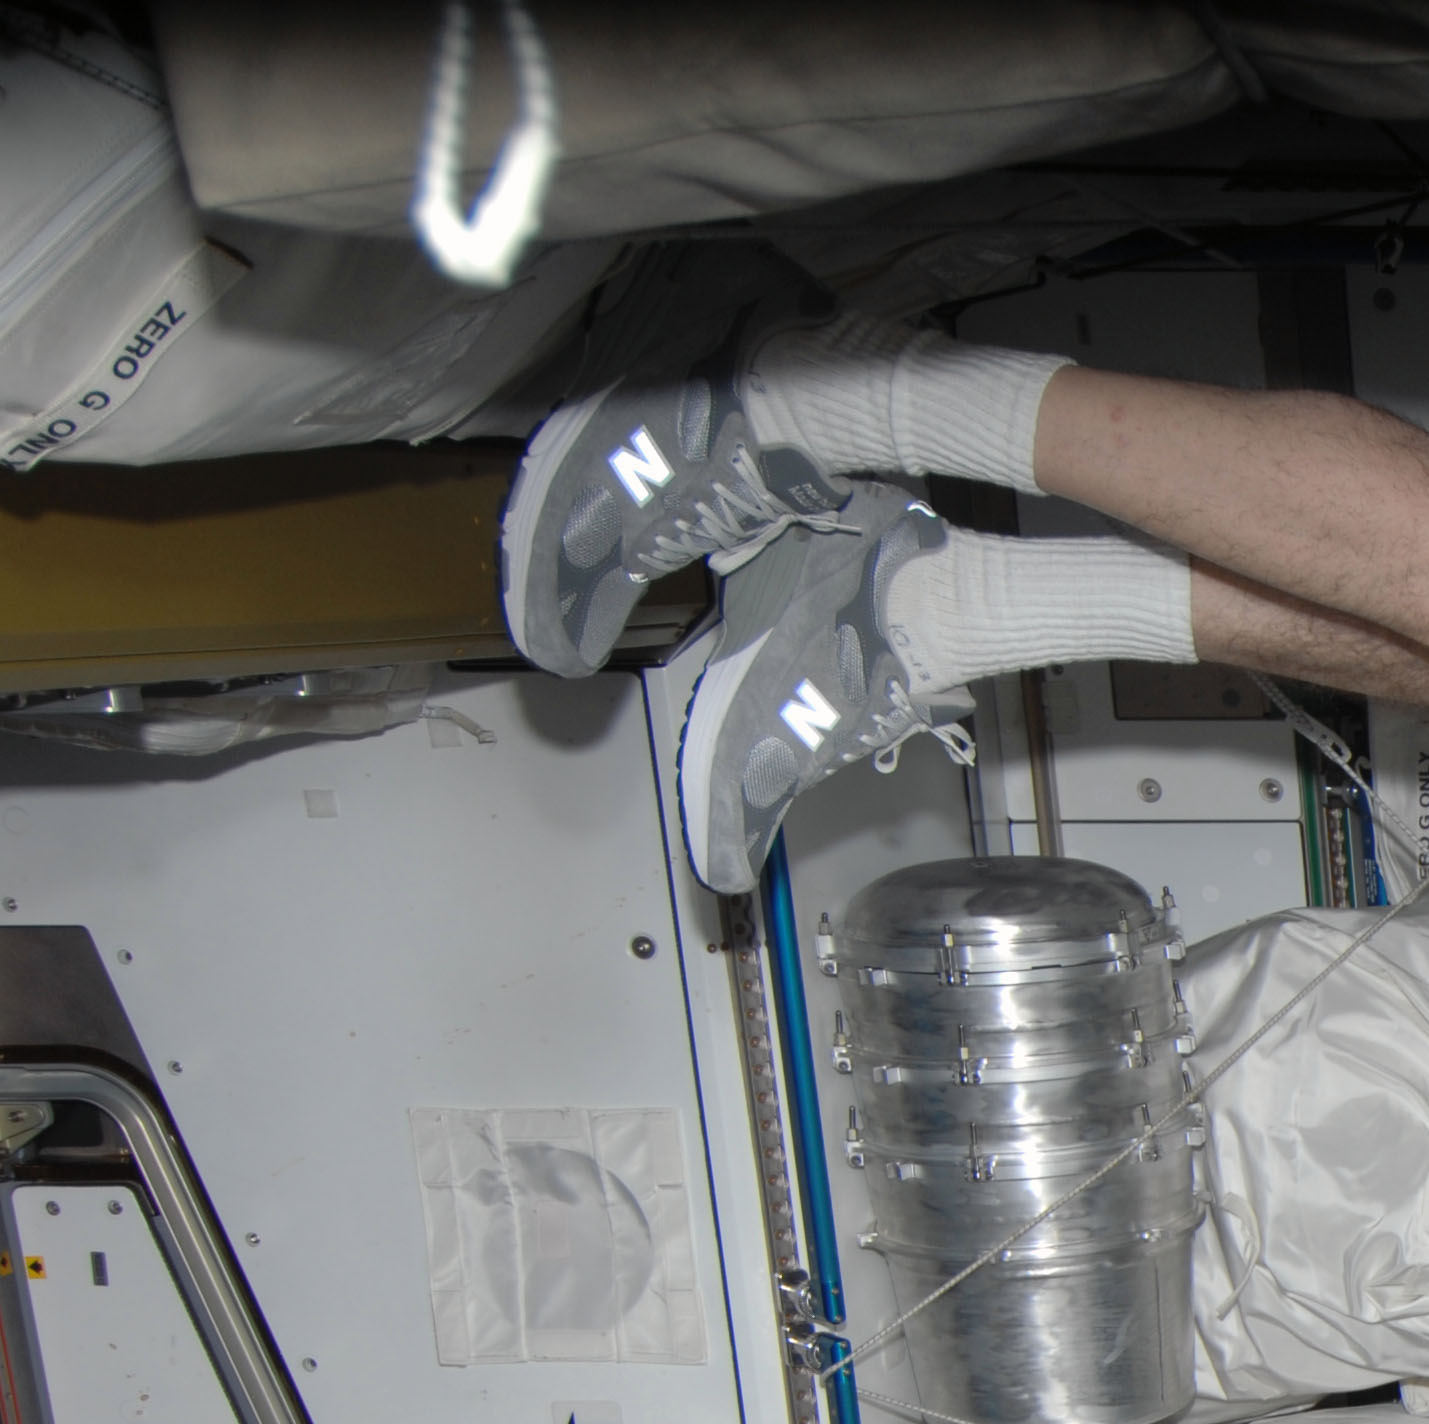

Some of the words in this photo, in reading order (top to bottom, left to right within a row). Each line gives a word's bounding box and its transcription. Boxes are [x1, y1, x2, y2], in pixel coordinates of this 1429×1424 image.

[104, 296, 189, 384] ZERO
[77, 383, 112, 418] G
[0, 402, 79, 486] ONLY
[609, 425, 675, 508] N
[780, 678, 841, 752] N
